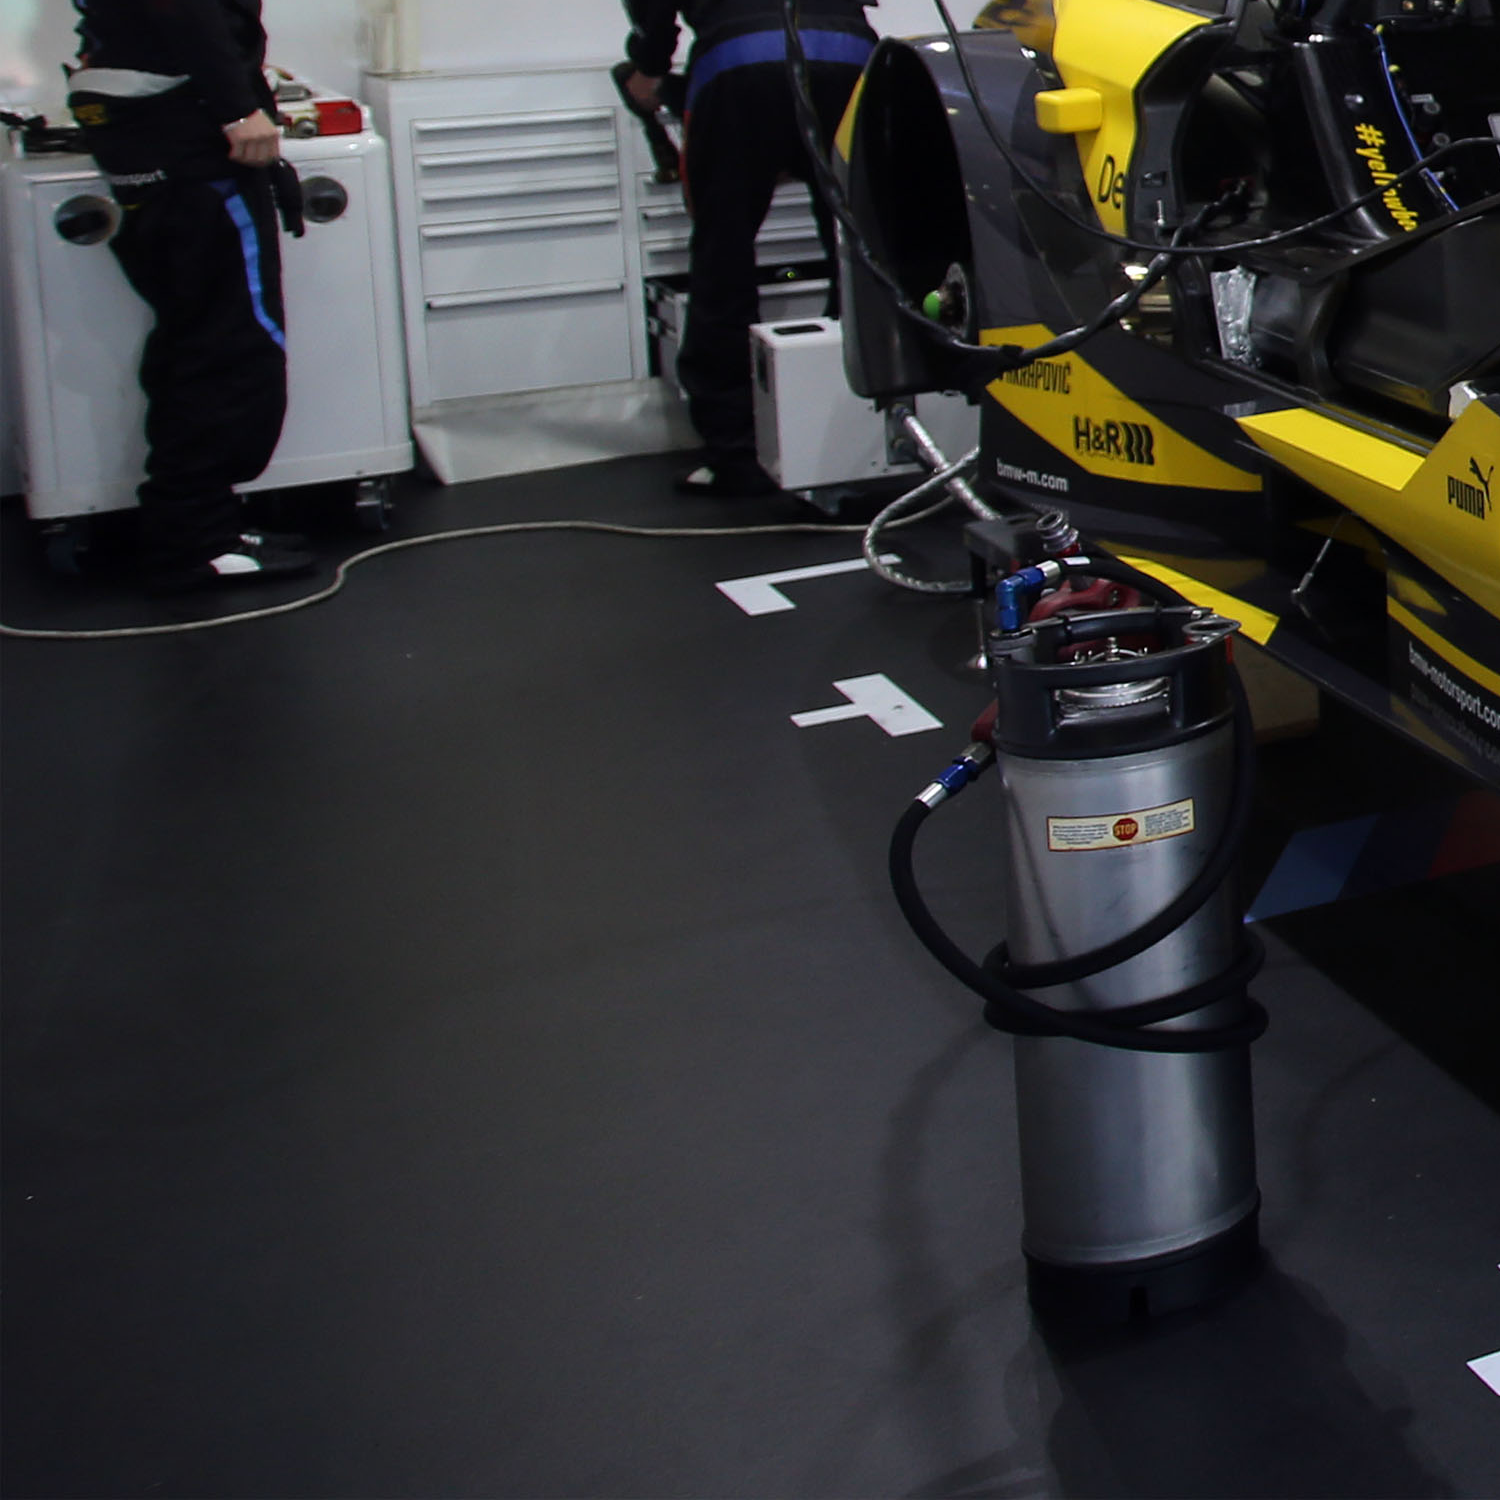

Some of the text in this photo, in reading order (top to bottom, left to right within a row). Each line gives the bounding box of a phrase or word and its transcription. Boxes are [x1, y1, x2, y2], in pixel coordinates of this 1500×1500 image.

[1074, 416, 1121, 456] H&R
[997, 458, 1069, 492] bmw-m.com
[1447, 474, 1485, 520] PUMA
[1114, 822, 1138, 834] STOP
